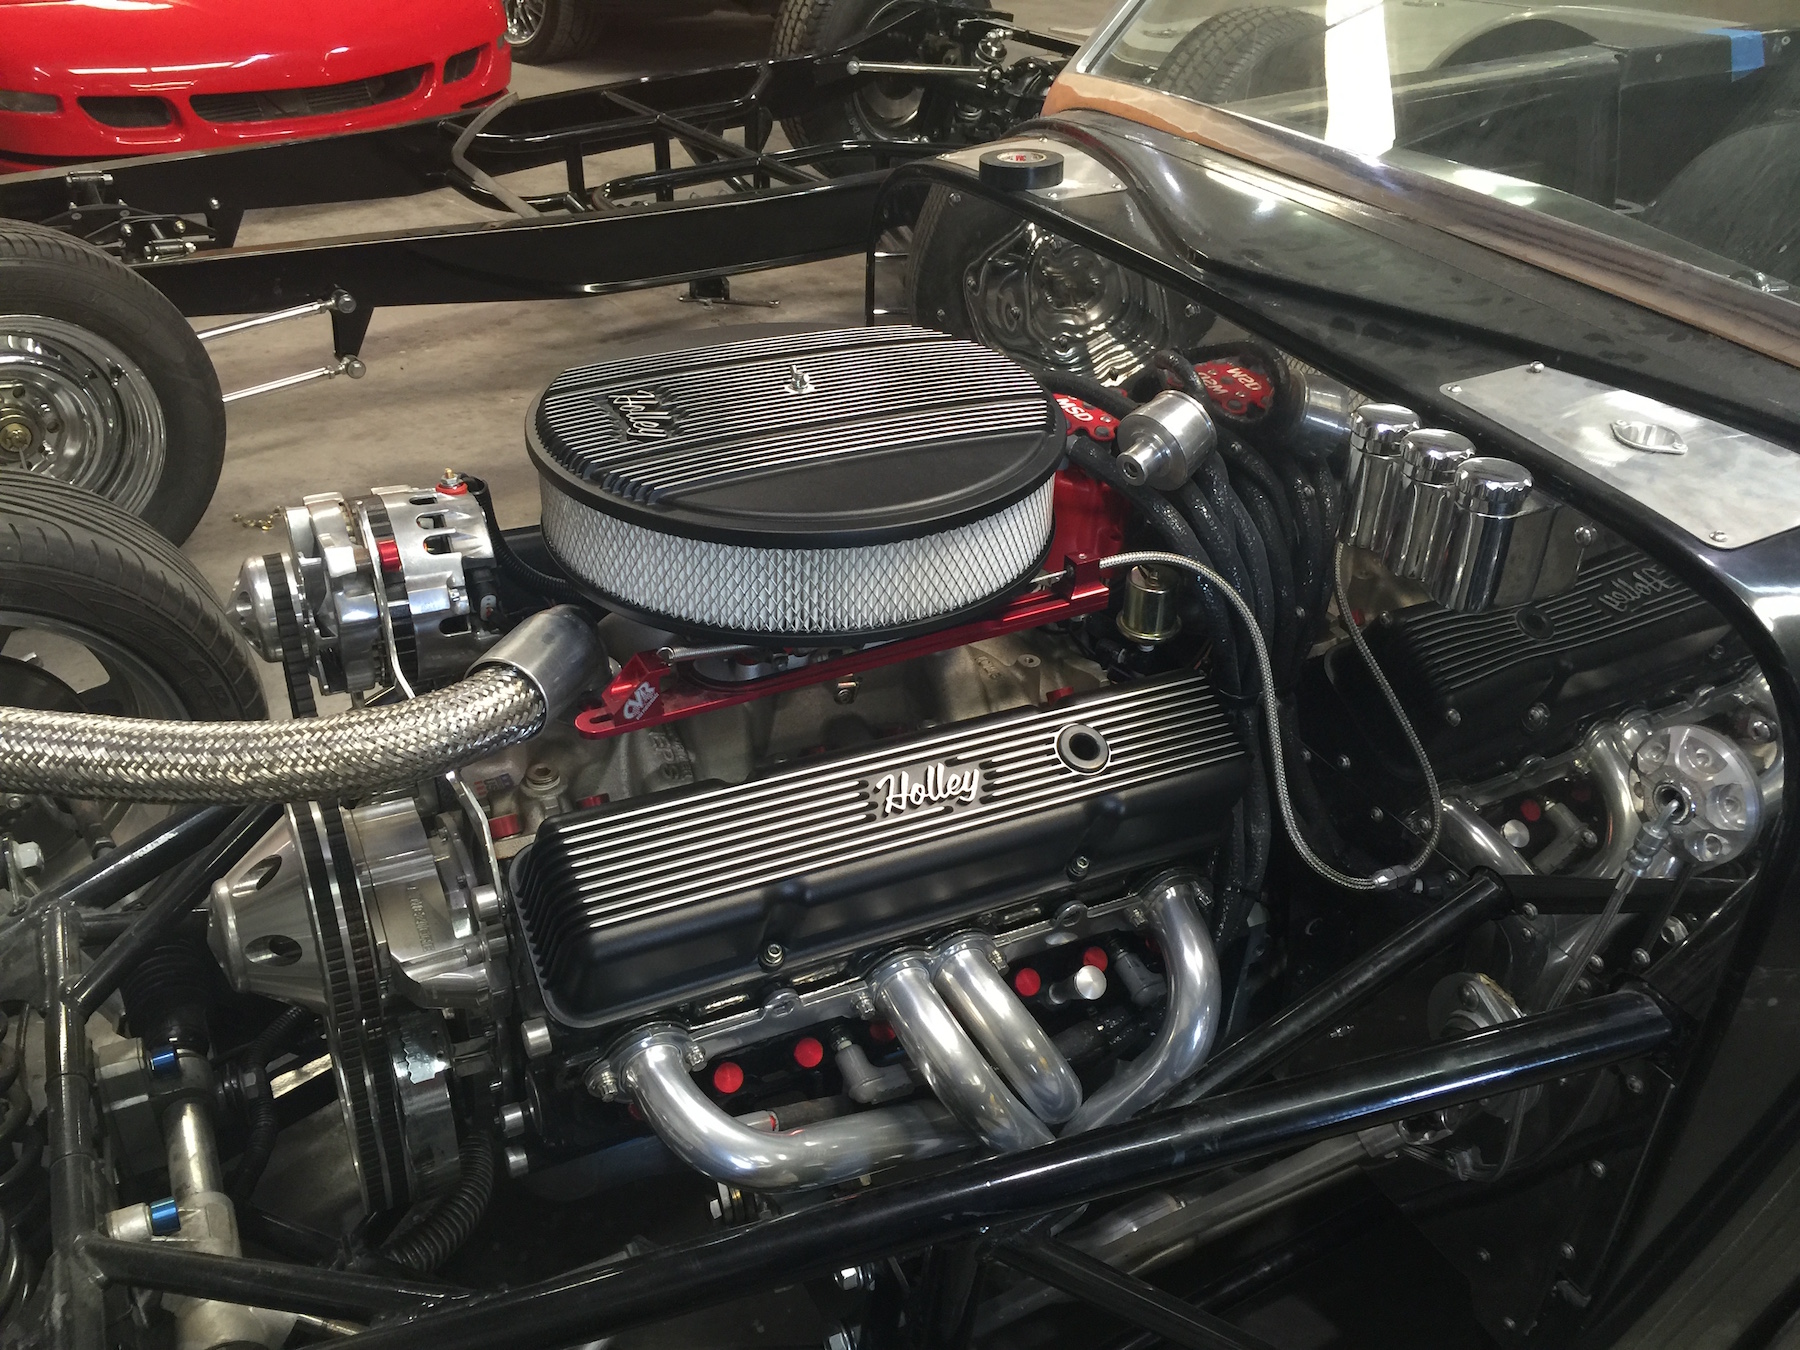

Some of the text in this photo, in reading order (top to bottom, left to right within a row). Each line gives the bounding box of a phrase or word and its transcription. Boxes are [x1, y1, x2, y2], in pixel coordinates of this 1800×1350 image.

[608, 389, 673, 438] Holley
[1056, 397, 1094, 421] MSD
[623, 681, 656, 720] CVR
[875, 762, 980, 814] Holley
